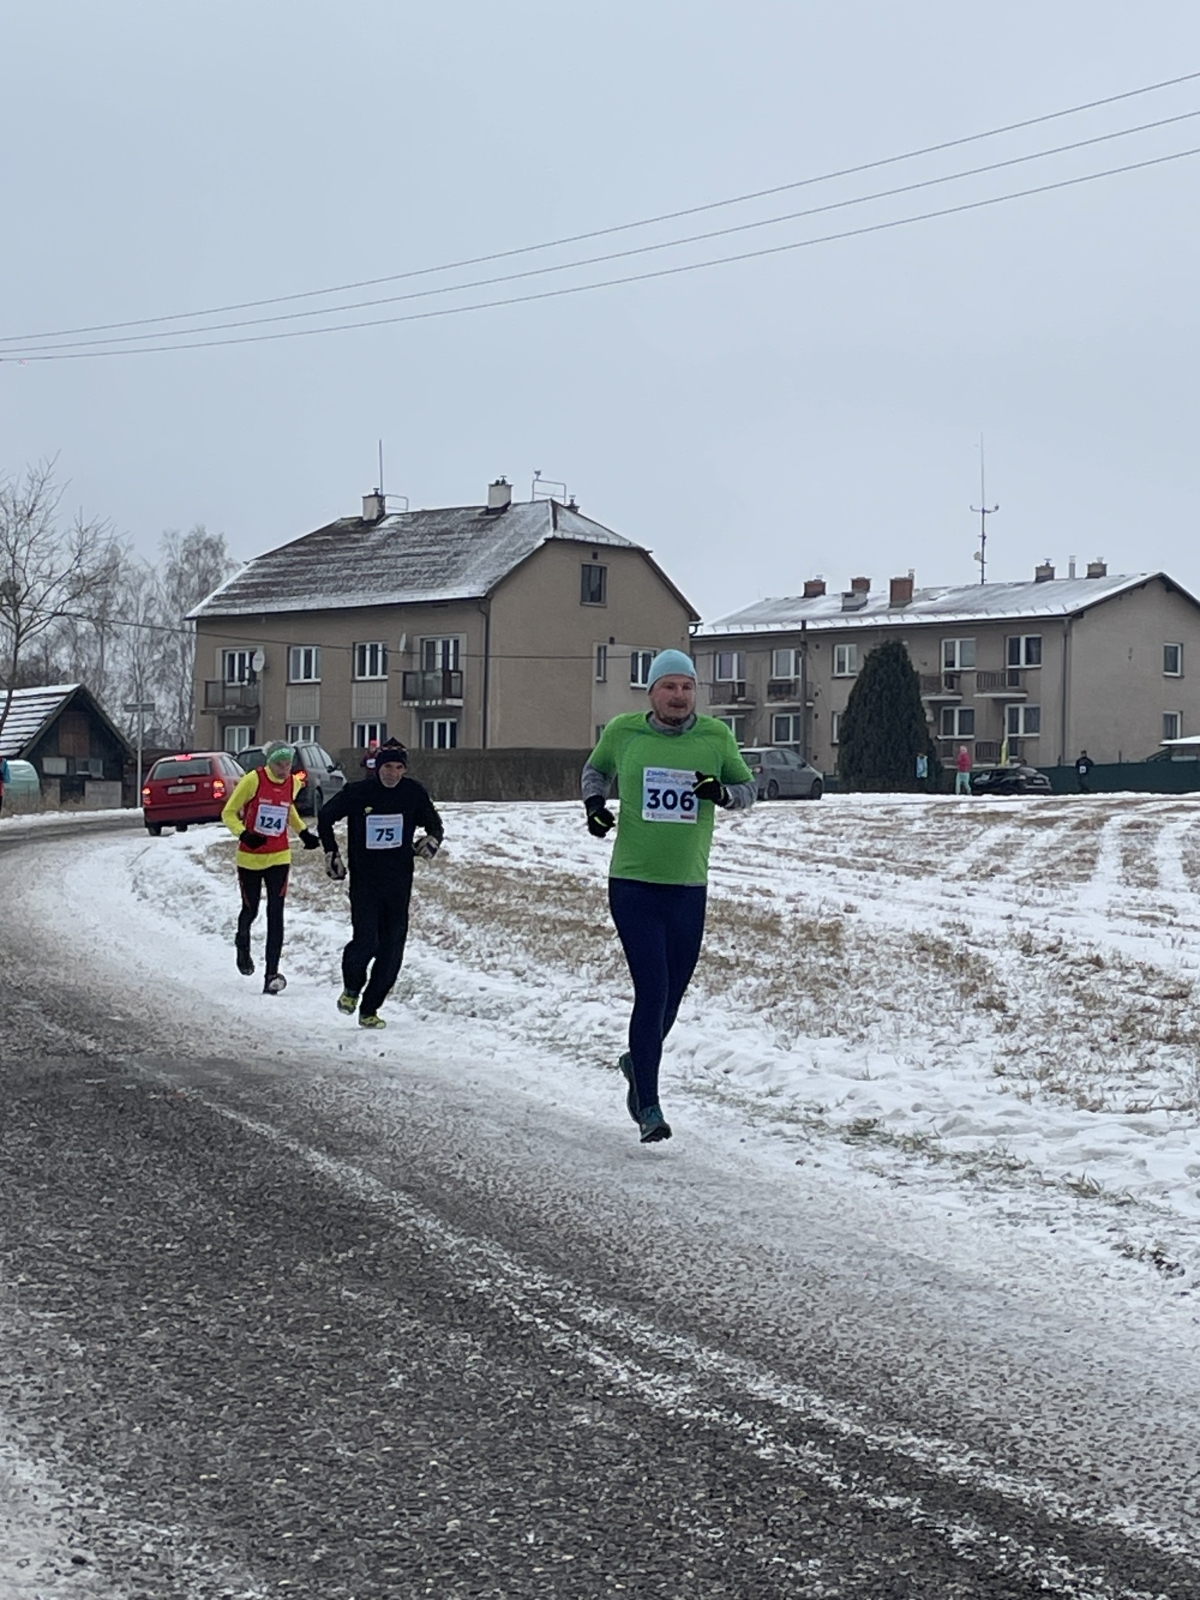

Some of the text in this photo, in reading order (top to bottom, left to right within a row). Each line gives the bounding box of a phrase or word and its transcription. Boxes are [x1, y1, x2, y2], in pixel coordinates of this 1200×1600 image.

[646, 788, 695, 812] 306
[260, 815, 282, 830] 124
[375, 828, 395, 842] 75
